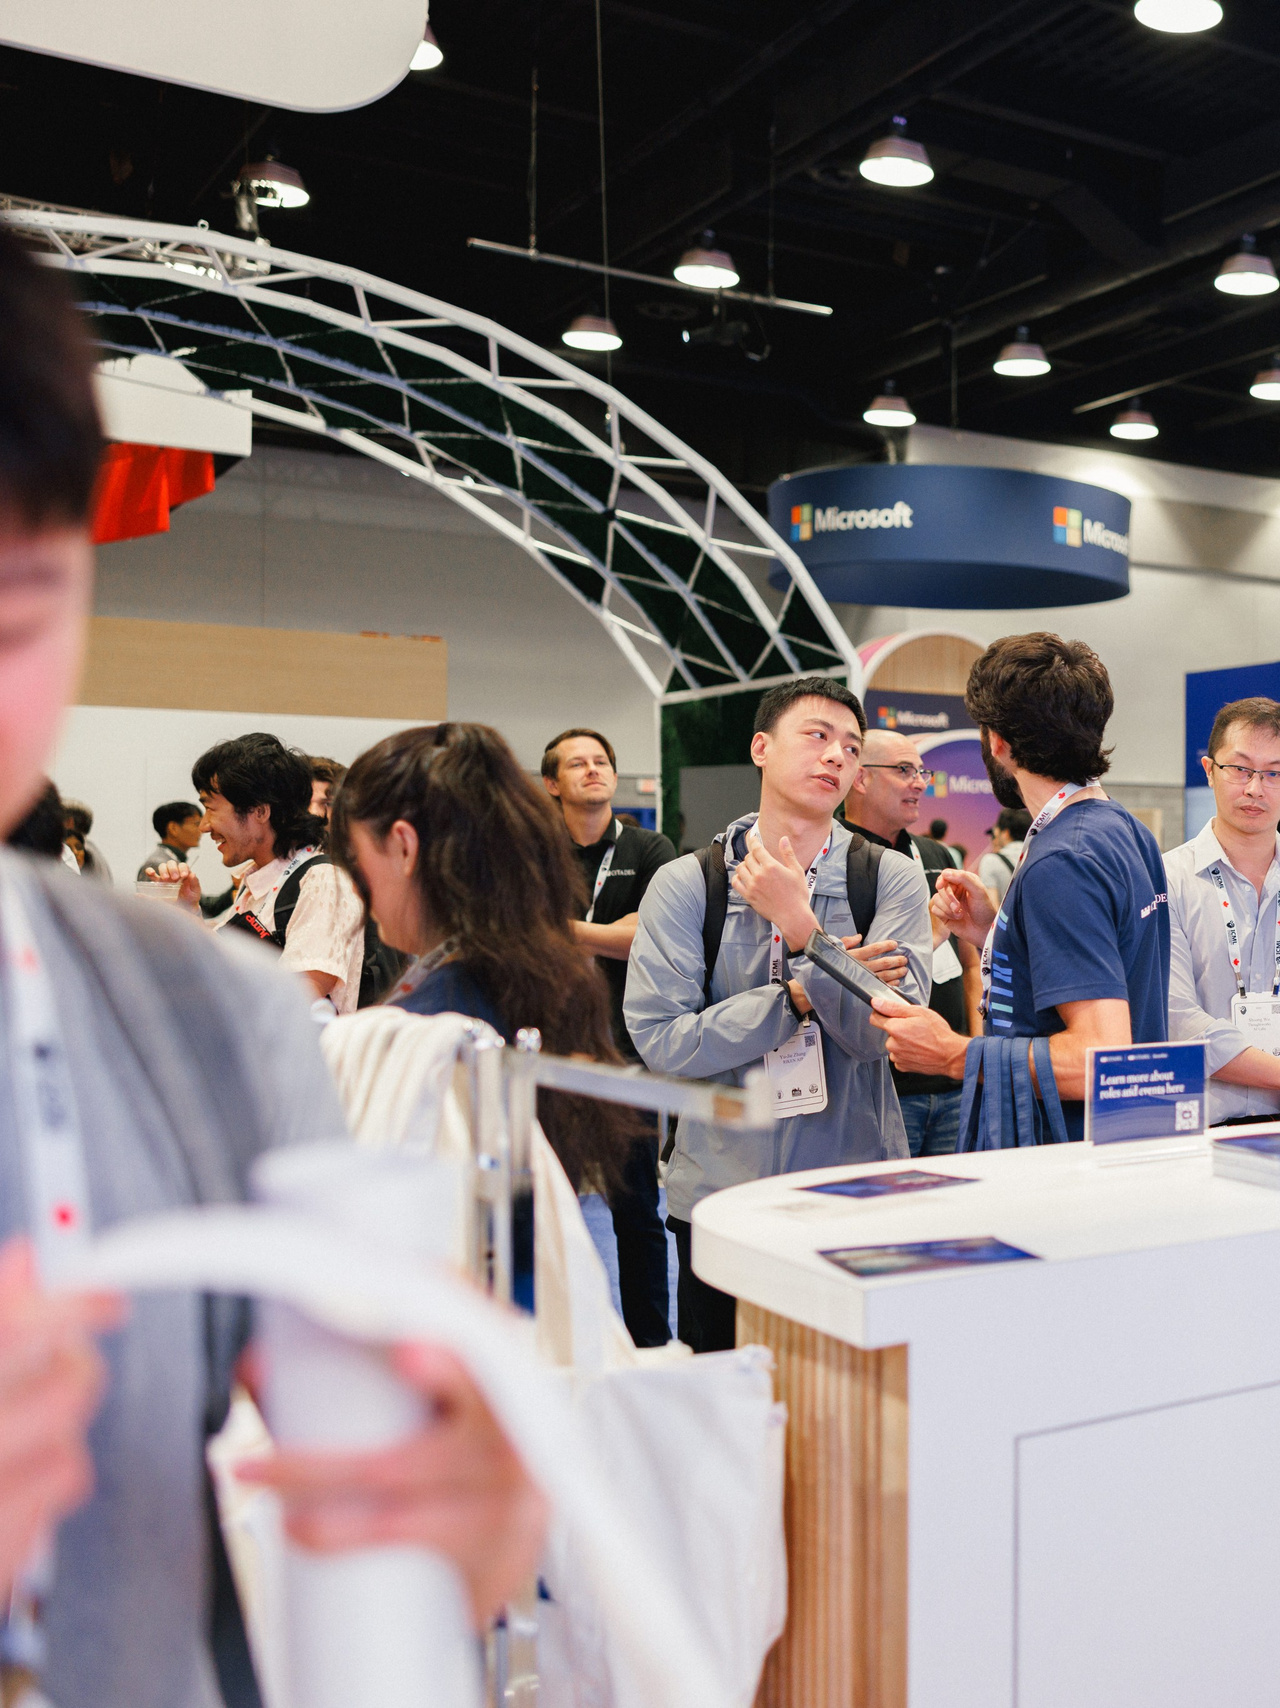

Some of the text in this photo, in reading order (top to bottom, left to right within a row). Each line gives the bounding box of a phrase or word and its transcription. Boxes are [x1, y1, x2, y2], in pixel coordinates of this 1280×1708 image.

[814, 501, 913, 532] Microsoft
[896, 710, 949, 728] Microsoft
[949, 774, 994, 795] Micro
[1034, 811, 1050, 828] ICML
[245, 914, 270, 939] Jump
[1230, 929, 1238, 945] ICML
[1100, 1069, 1174, 1086] Learn more about
[1099, 1082, 1185, 1100] roles and events here
